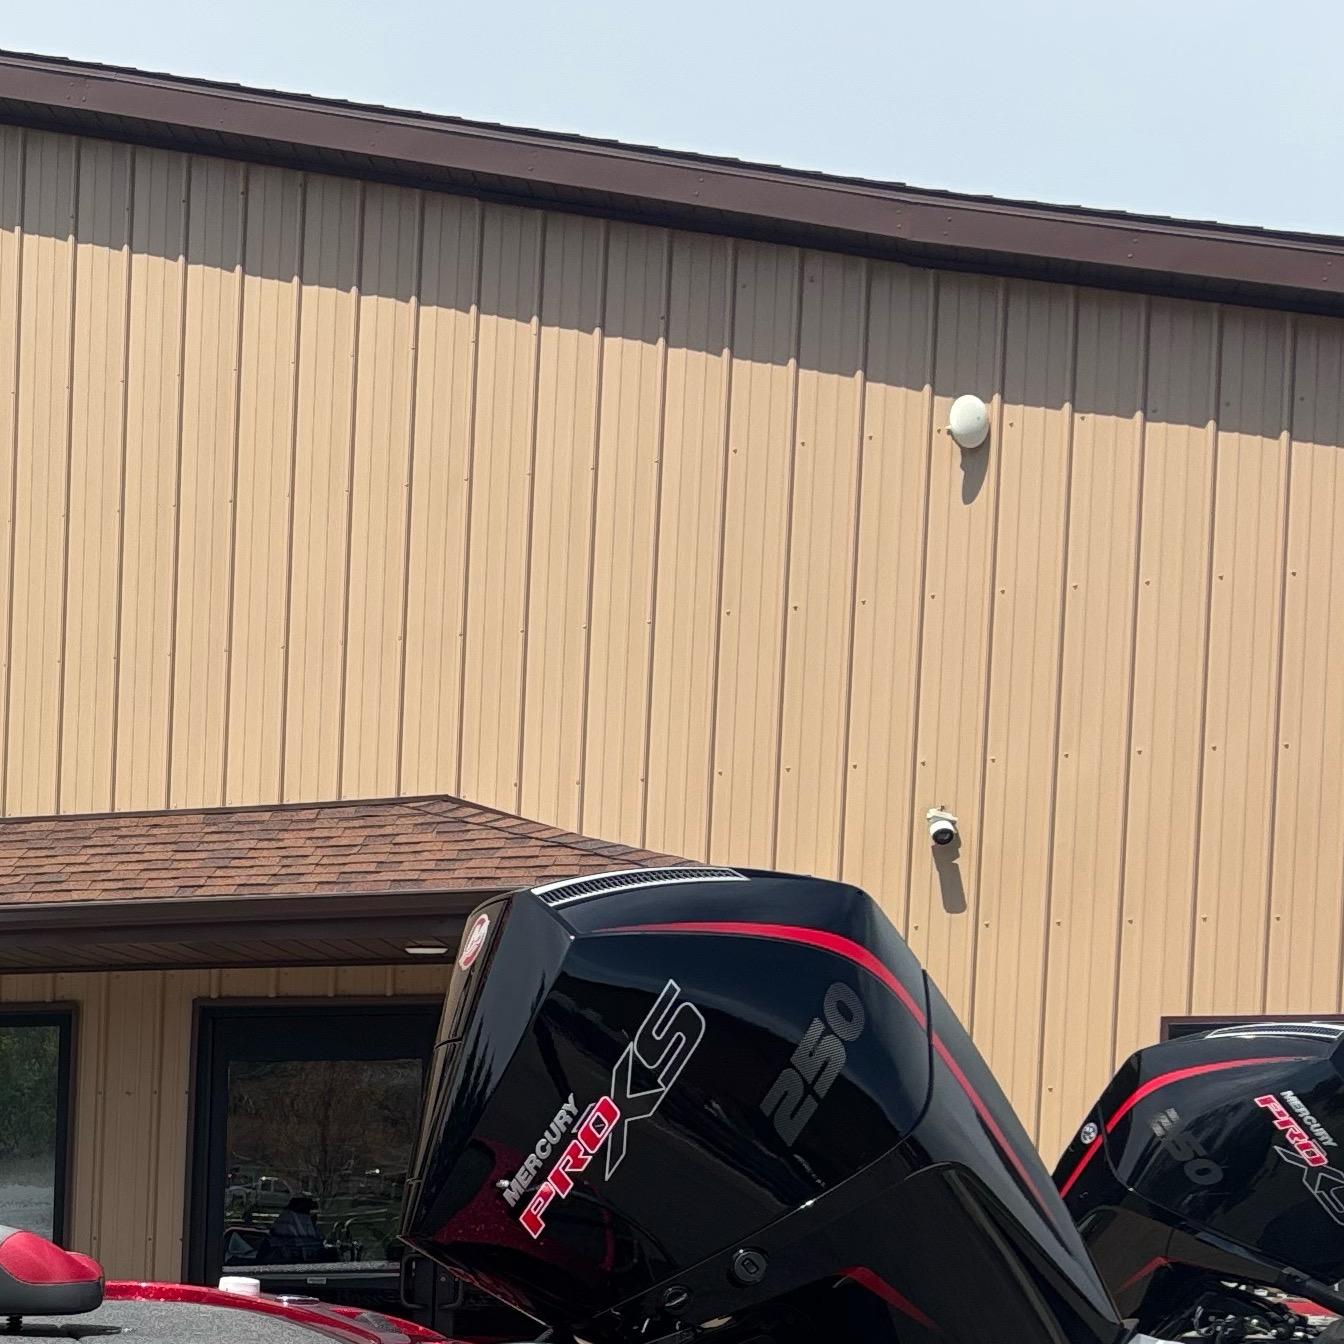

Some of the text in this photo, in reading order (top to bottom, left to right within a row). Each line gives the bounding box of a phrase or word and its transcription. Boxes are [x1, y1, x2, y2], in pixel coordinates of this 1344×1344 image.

[519, 978, 706, 1239] PRO XS
[760, 981, 866, 1147] 250
[1279, 1090, 1339, 1147] MERCURY
[501, 1092, 581, 1207] MERCURY
[1254, 1094, 1329, 1167] PRO
